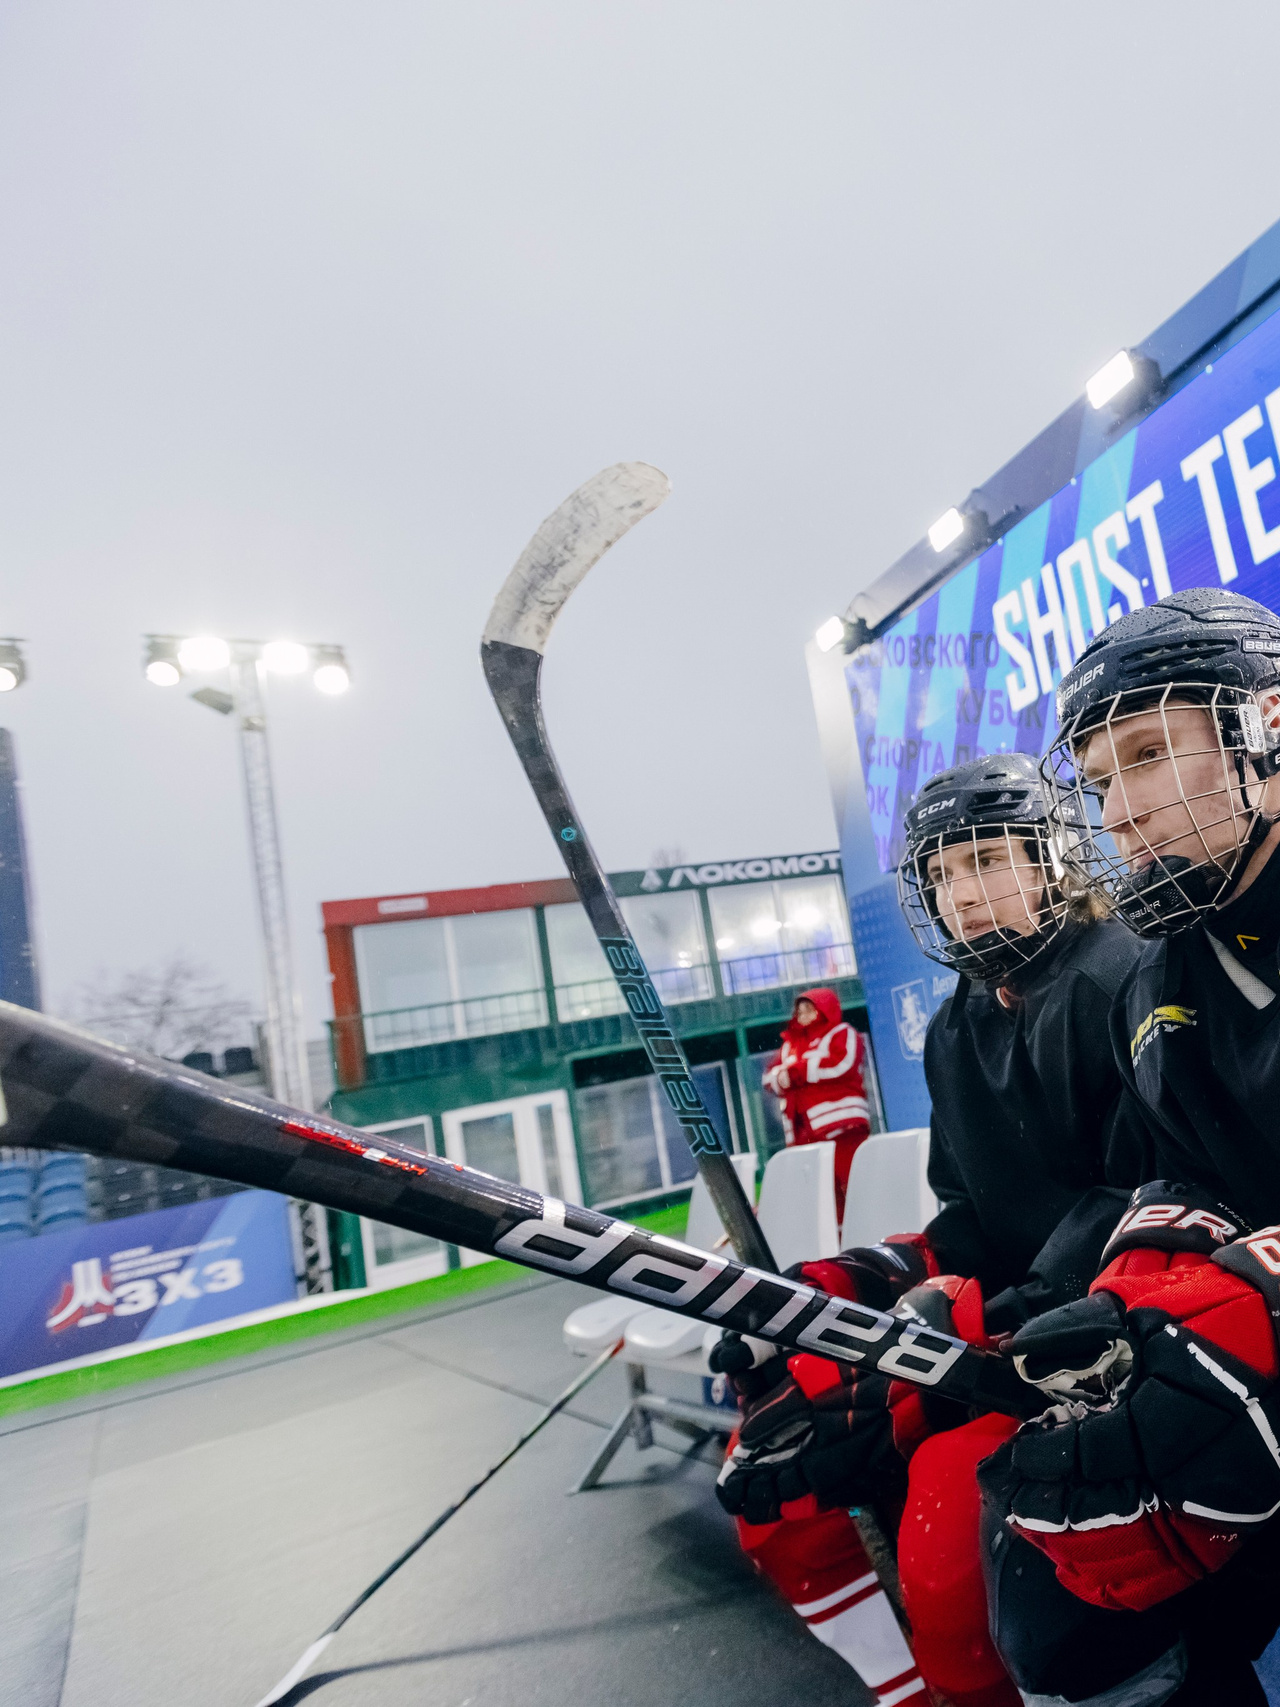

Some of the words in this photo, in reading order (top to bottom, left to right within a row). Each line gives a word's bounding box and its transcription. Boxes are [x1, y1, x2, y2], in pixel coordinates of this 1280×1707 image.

[991, 479, 1173, 713] SHOST
[853, 632, 999, 669] КОВСКОГО
[1058, 662, 1105, 705] AUER
[864, 733, 946, 774] СПОРТА
[917, 797, 957, 820] CCM
[668, 853, 840, 888] ЛОКОМОТ
[1216, 1201, 1254, 1233] HYPERLIT
